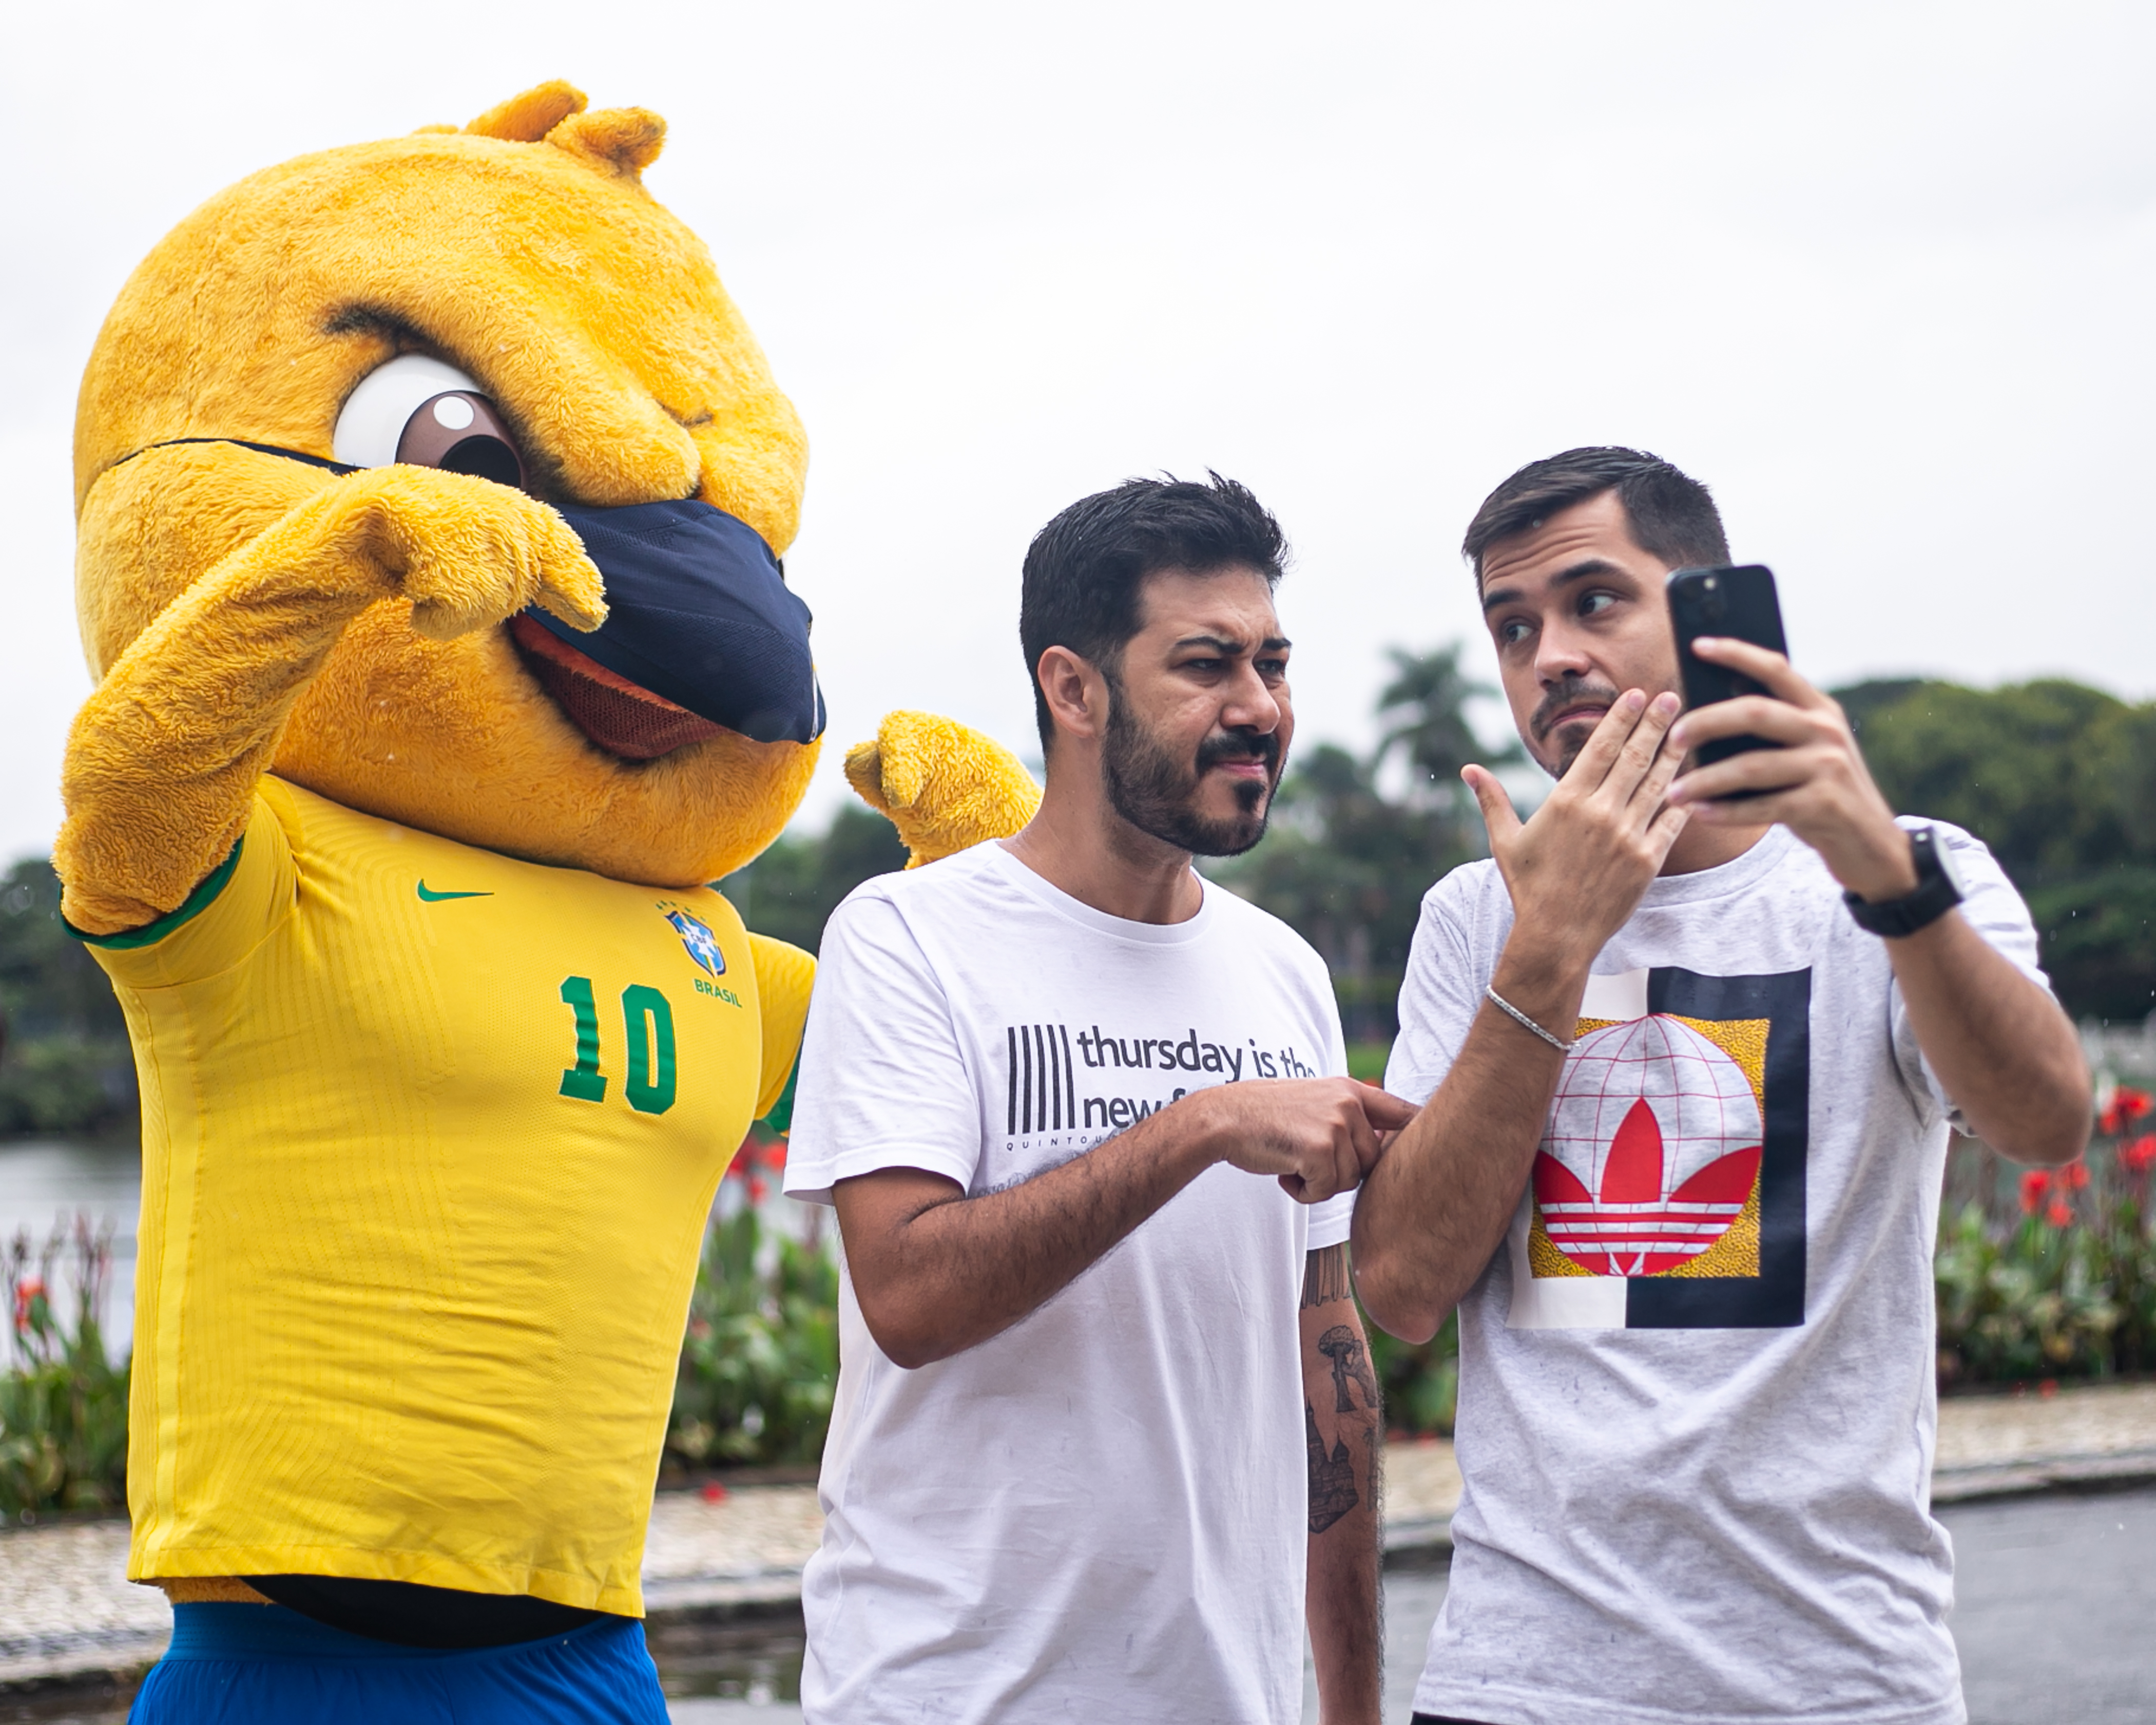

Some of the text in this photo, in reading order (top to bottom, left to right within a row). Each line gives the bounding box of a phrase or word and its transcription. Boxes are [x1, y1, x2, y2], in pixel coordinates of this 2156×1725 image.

[690, 933, 707, 944] CBF
[694, 978, 742, 1008] BRASIL
[558, 975, 677, 1115] 10
[1076, 1025, 1242, 1084] thursday
[1248, 1039, 1278, 1078] is
[1083, 1097, 1162, 1128] new
[1006, 1135, 1102, 1151] QUINTOU
